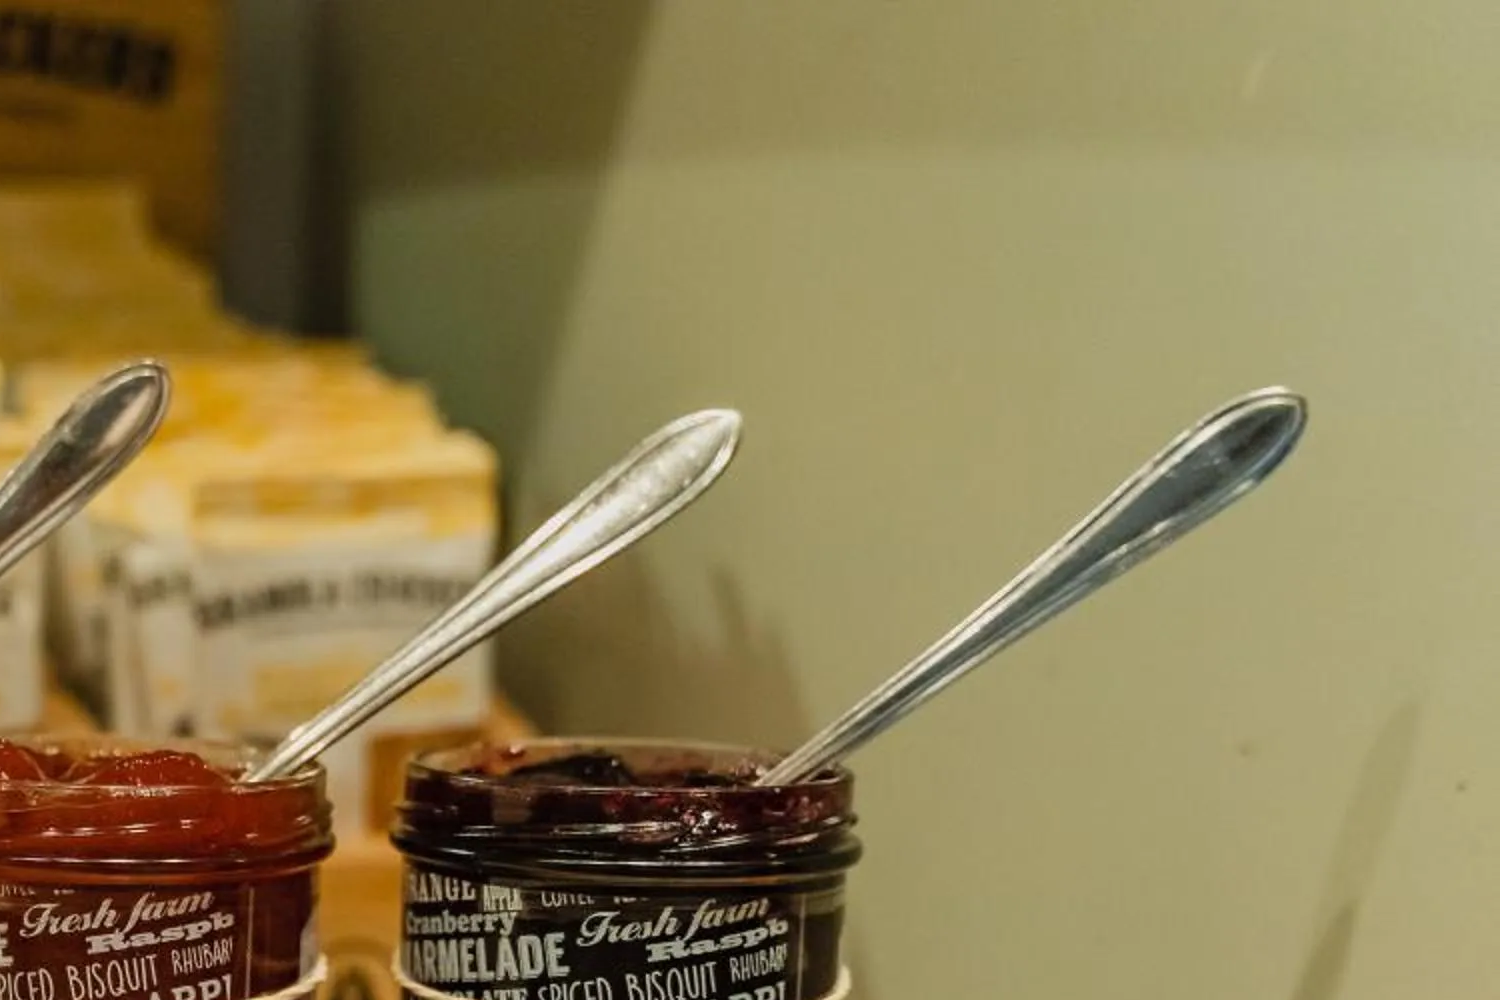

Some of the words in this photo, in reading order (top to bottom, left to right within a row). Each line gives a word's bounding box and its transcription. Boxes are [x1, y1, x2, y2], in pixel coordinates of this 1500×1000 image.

[19, 897, 120, 938] Fresh
[122, 891, 214, 934] farm
[86, 911, 235, 955] Raspb
[576, 905, 679, 947] Fresh
[681, 897, 770, 941] farm
[171, 936, 233, 977] RHUBAR
[645, 918, 789, 962] Raspb
[729, 943, 788, 983] RHUBAR
